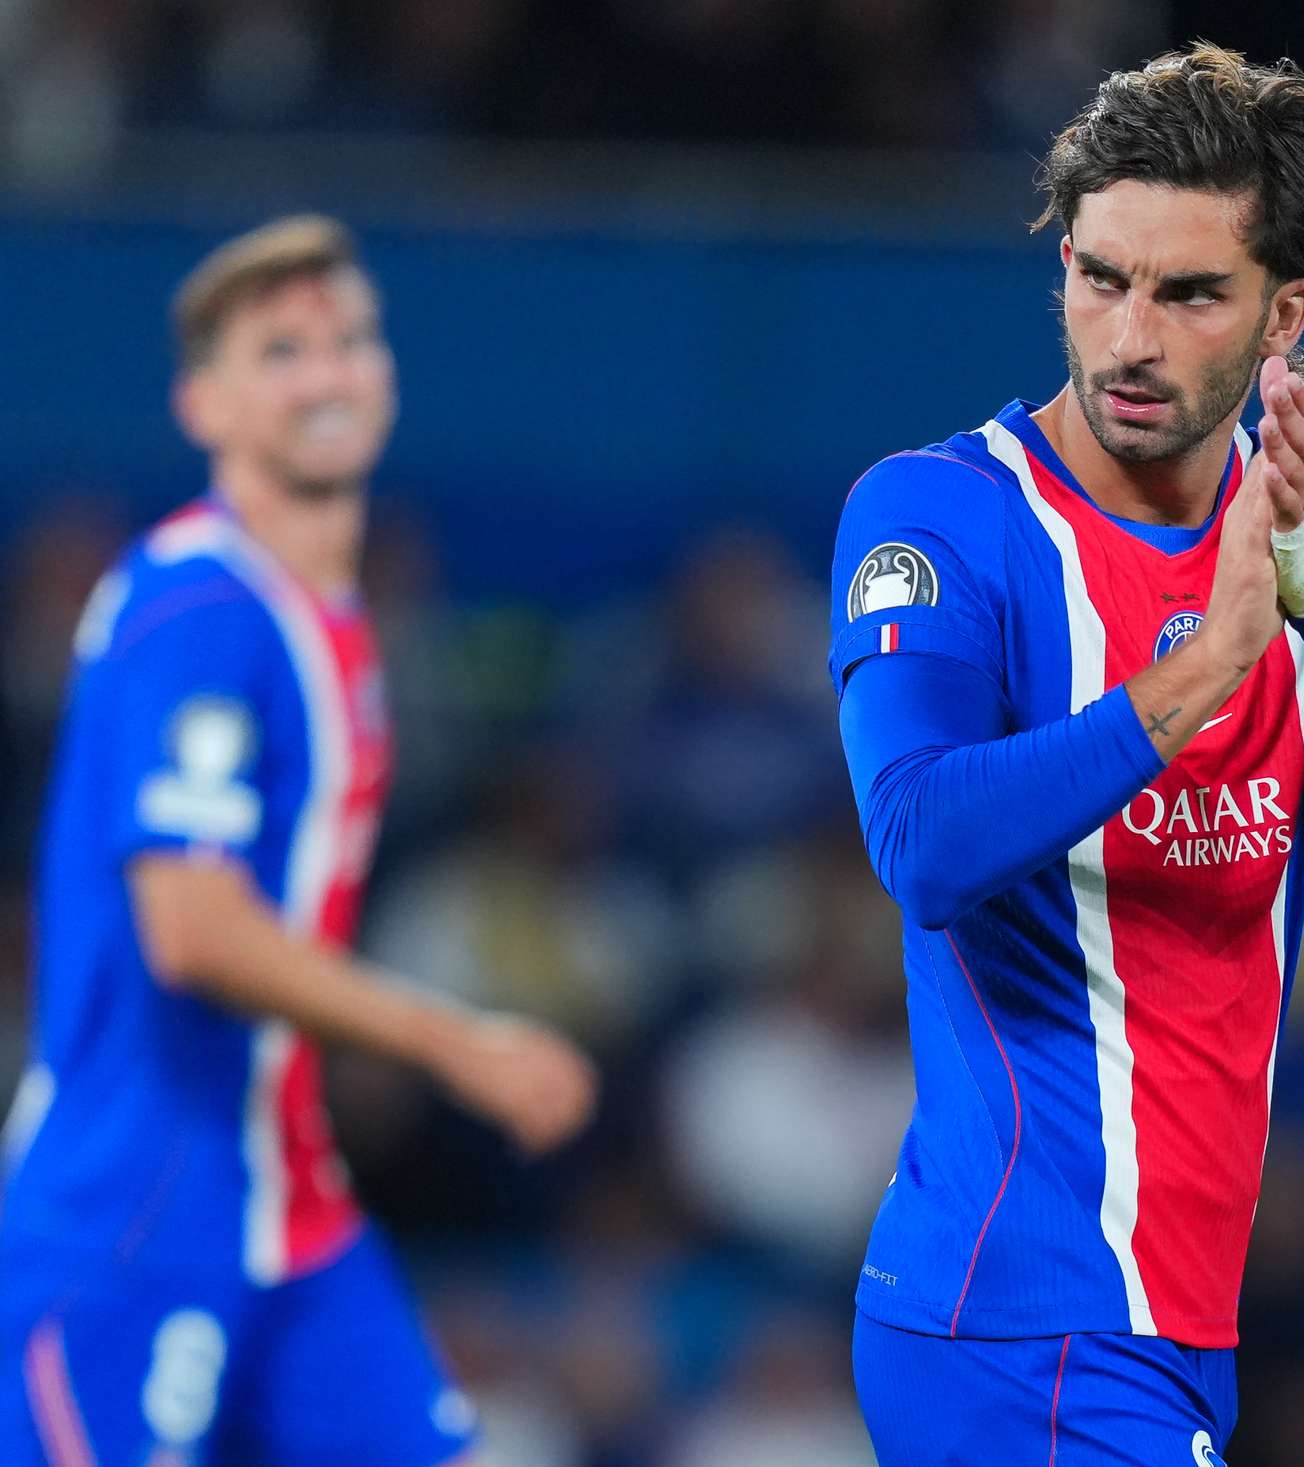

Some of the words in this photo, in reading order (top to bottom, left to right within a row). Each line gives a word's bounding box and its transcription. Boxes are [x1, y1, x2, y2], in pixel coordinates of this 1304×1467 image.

[1164, 617, 1204, 640] PARI
[1121, 776, 1290, 846] QATAR
[1163, 825, 1293, 868] AIRWAYS
